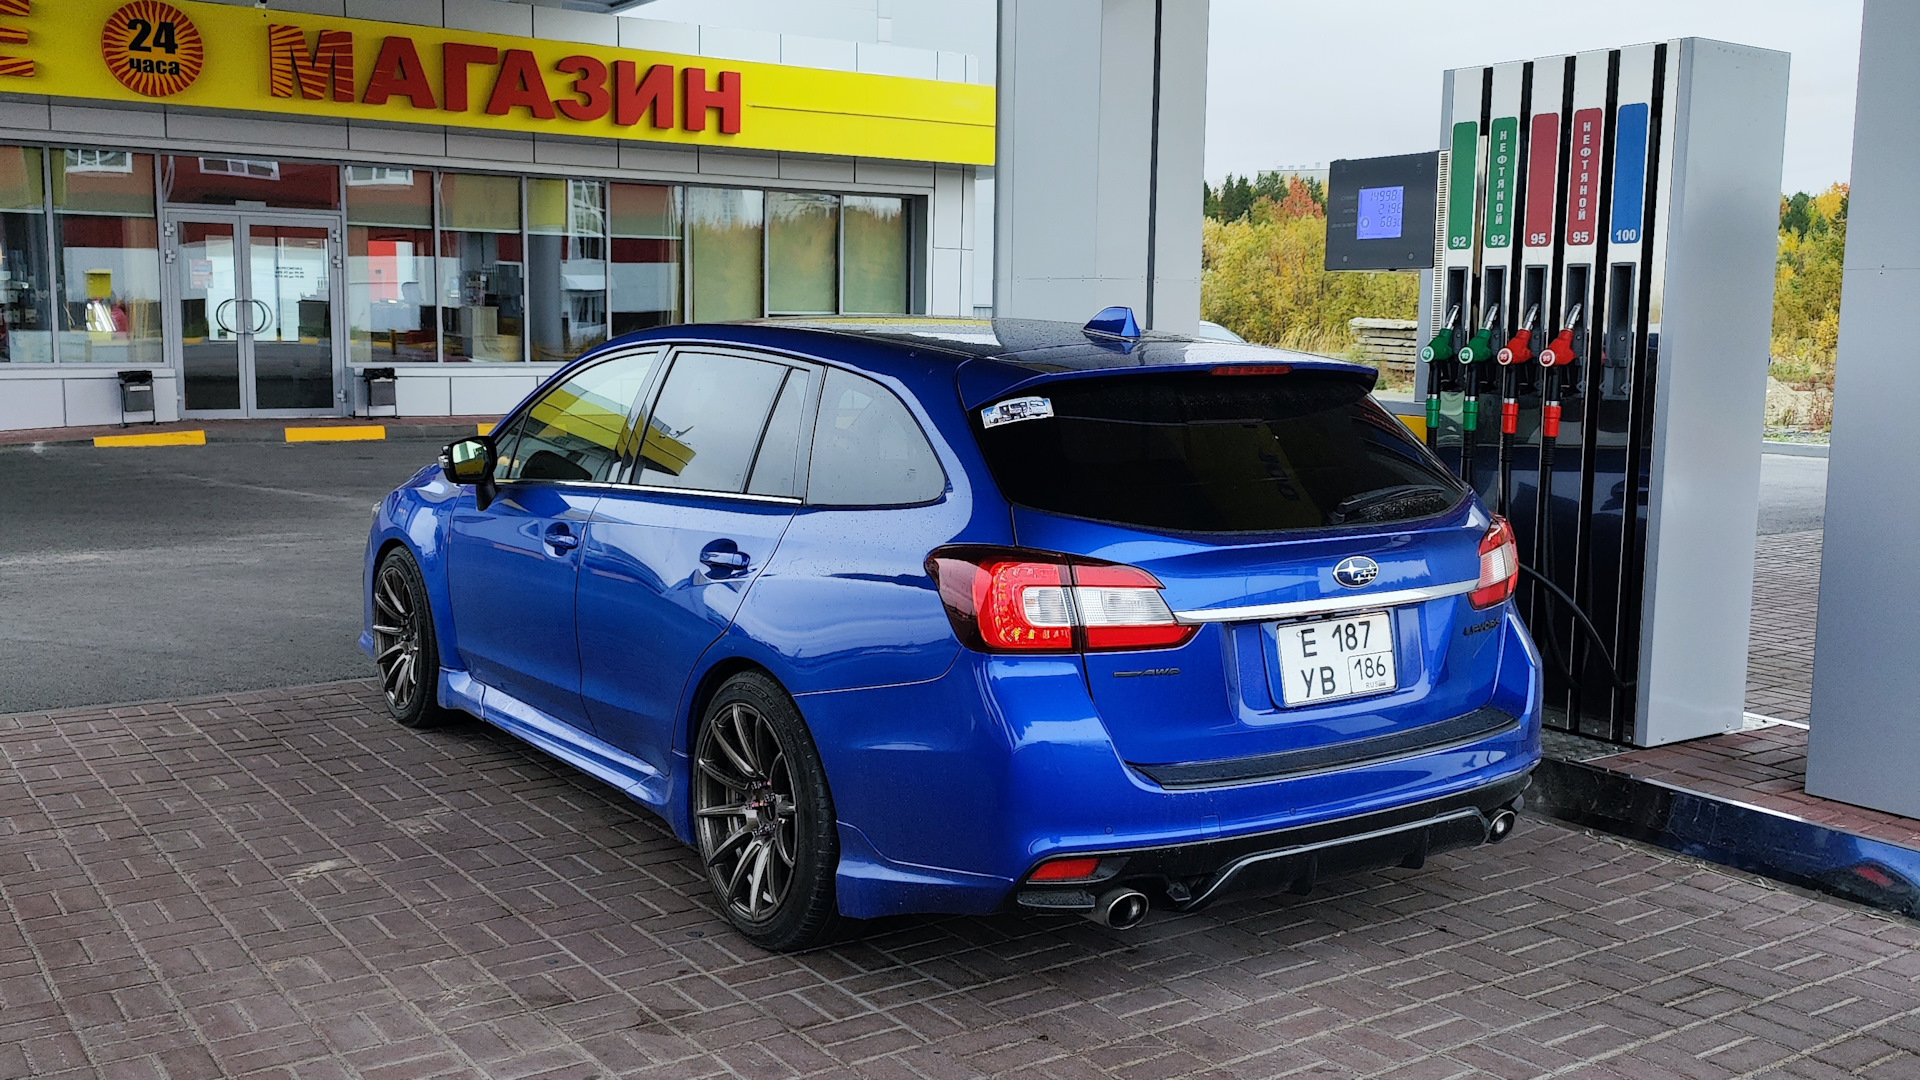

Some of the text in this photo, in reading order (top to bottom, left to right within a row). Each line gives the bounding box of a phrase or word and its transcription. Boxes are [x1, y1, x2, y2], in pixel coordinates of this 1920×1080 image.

[127, 18, 179, 55] 24
[129, 57, 181, 77] часа
[268, 23, 741, 135] МАГАЗИН
[1494, 130, 1508, 225] НЕФТЯНОЙ
[1577, 121, 1592, 221] НЕФТЯНОЙ
[1452, 236, 1467, 248] 92
[1490, 234, 1506, 246] 92
[1530, 232, 1547, 245] 95
[1572, 230, 1589, 244] 95
[1615, 228, 1637, 242] 100
[1300, 620, 1371, 658] Е 187
[1354, 655, 1386, 680] 186
[1300, 665, 1336, 698] УВ
[1365, 681, 1379, 689] RUS
